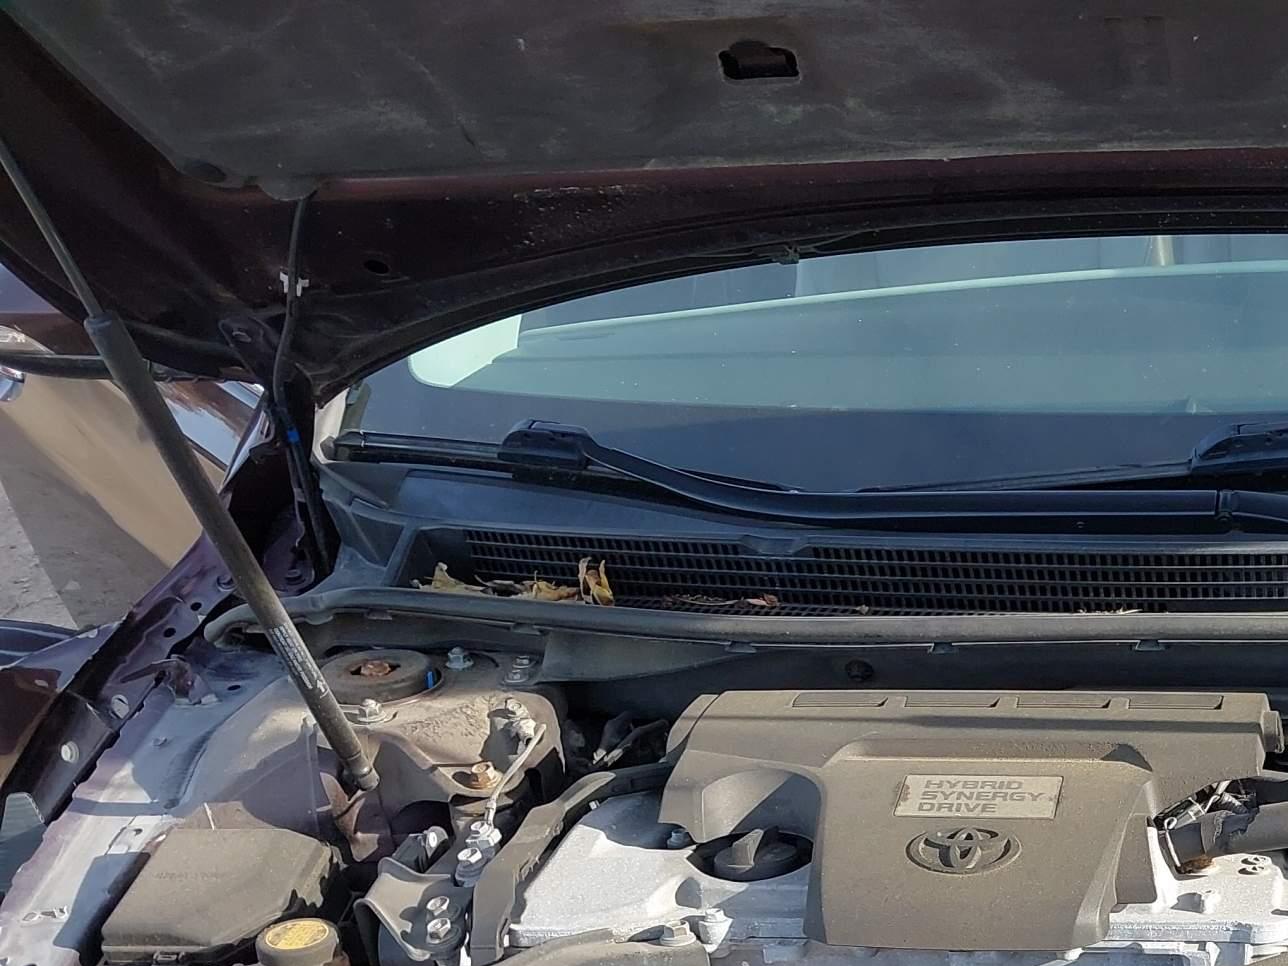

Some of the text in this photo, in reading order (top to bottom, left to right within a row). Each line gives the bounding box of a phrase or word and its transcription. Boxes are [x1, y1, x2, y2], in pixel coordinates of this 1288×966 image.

[924, 779, 1024, 790] HYBRID
[920, 790, 1046, 802] SYNERGY
[917, 802, 998, 813] DRIVE
